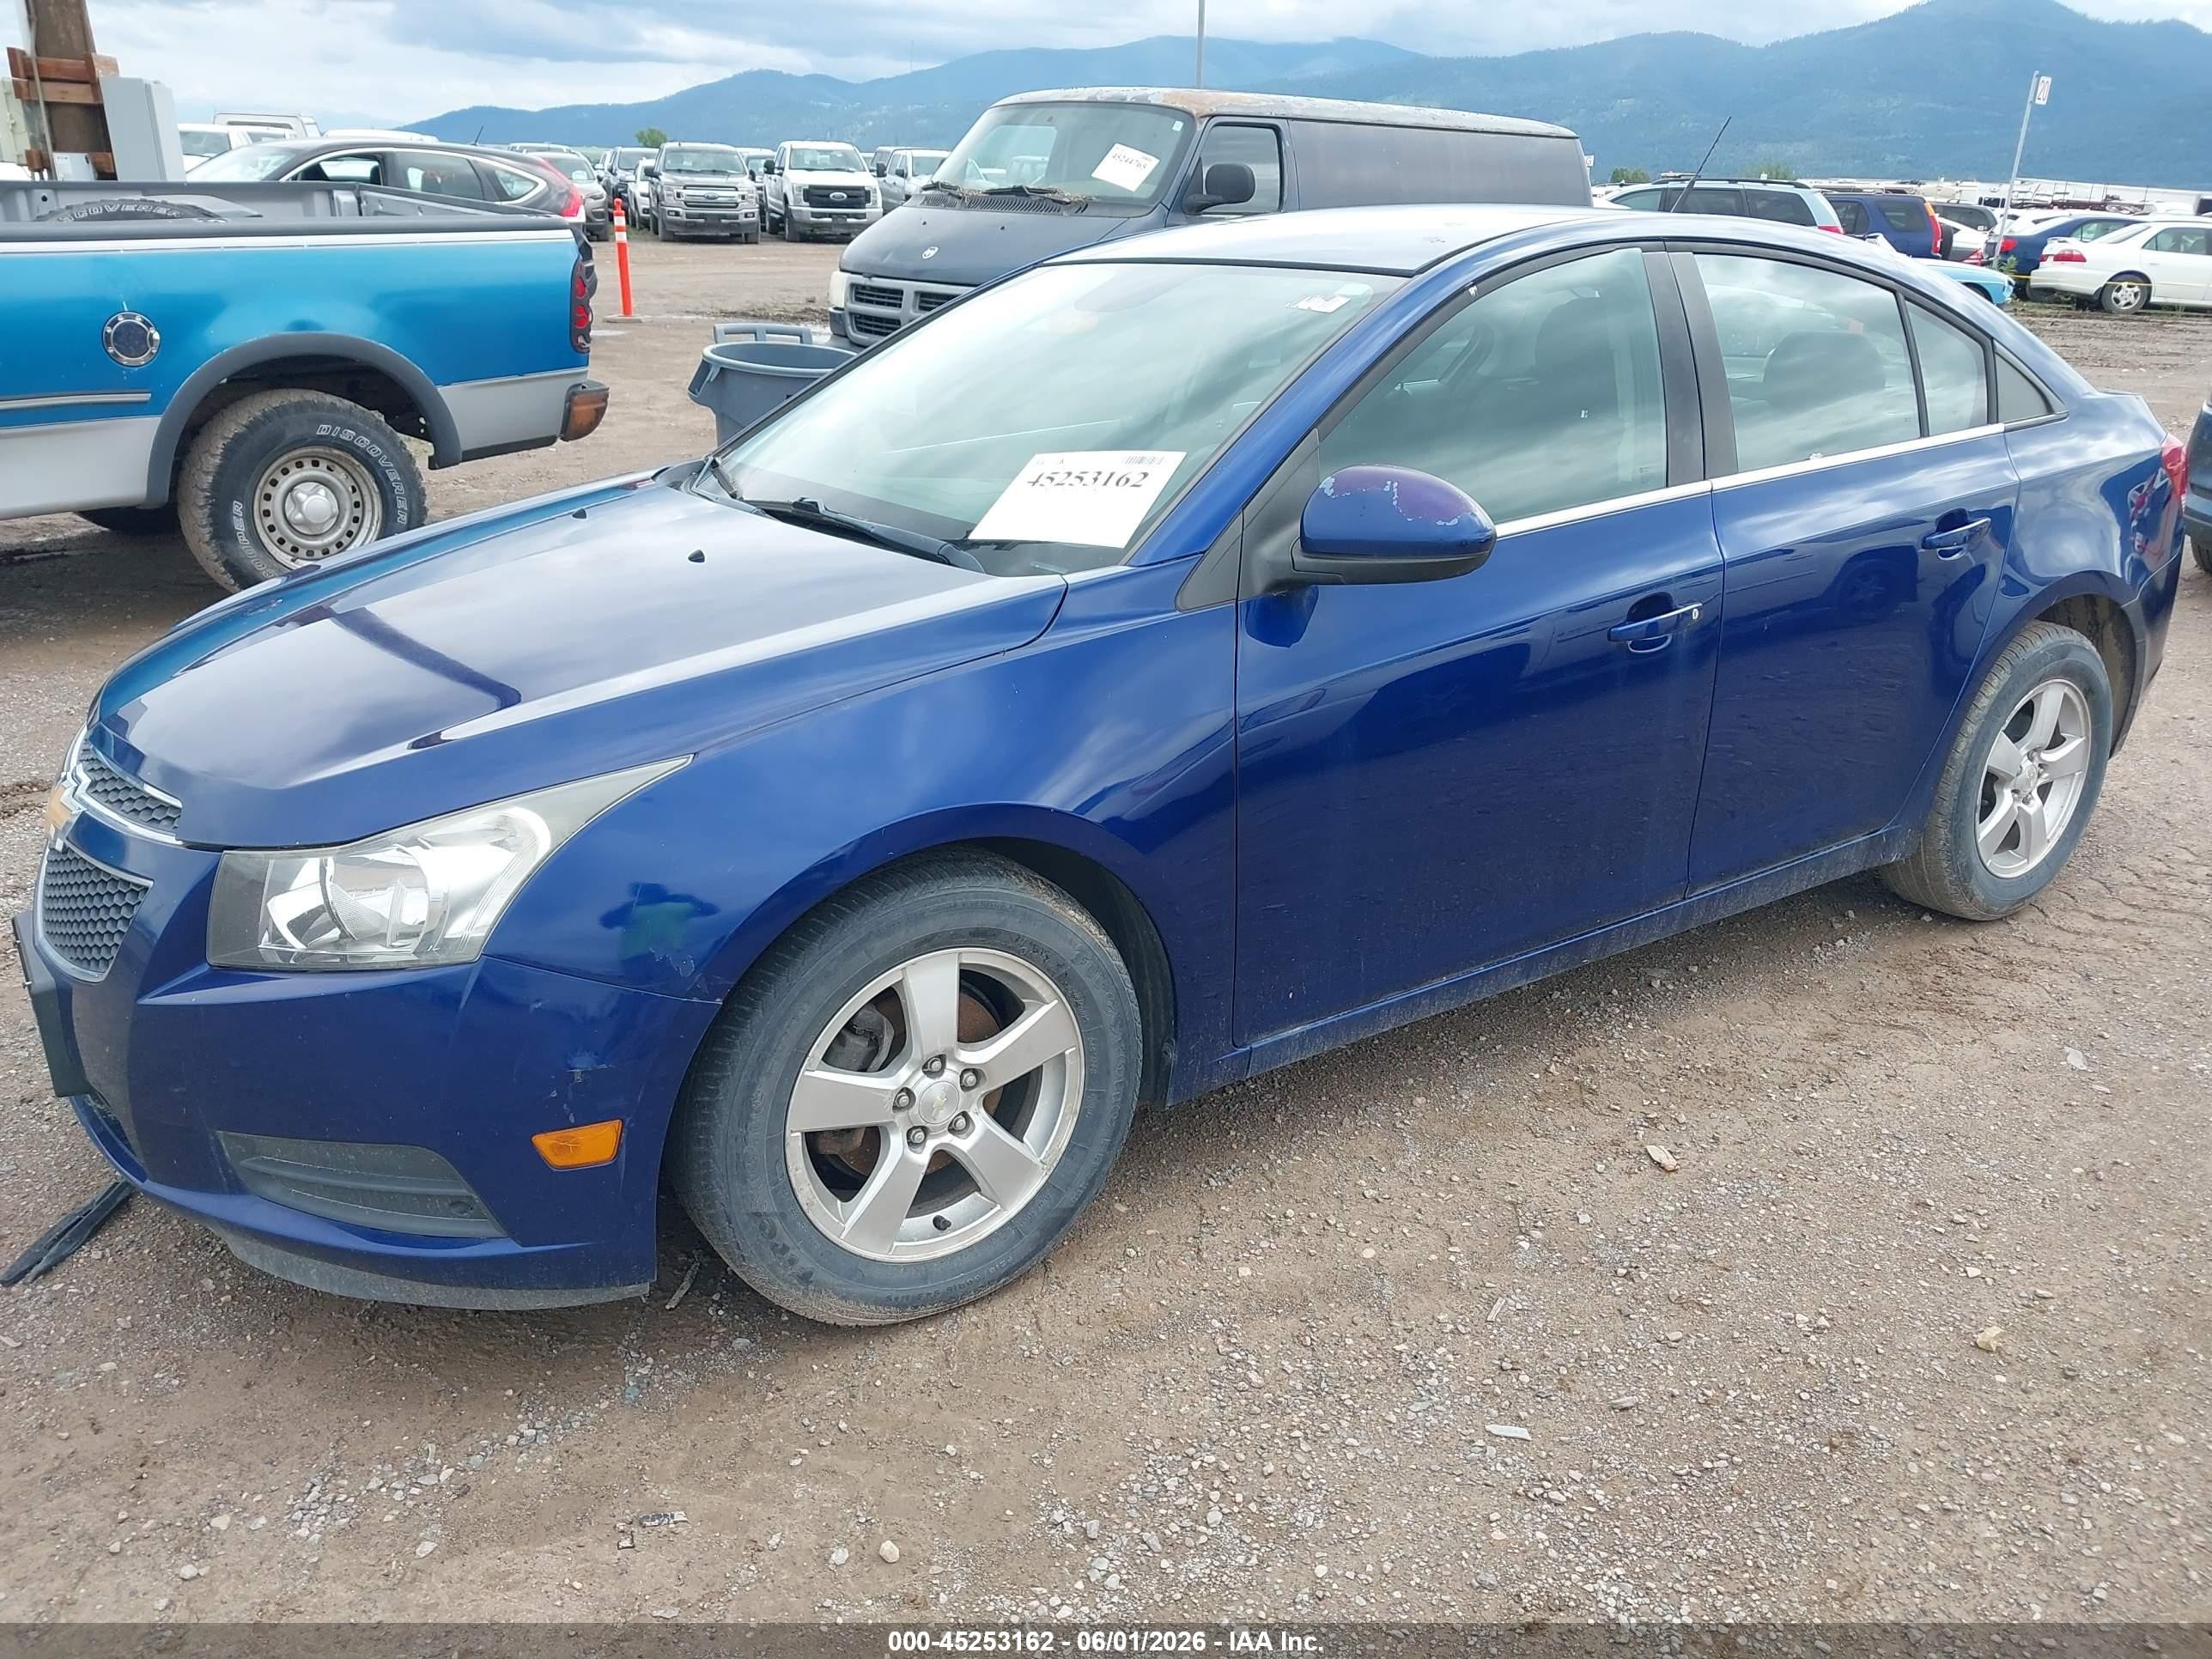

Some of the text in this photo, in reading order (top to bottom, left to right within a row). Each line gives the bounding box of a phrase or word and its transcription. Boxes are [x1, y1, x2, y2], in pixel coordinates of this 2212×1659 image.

[2037, 79, 2050, 101] 20
[316, 424, 408, 525] DISCOVERER
[1027, 471, 1149, 488] 45253162
